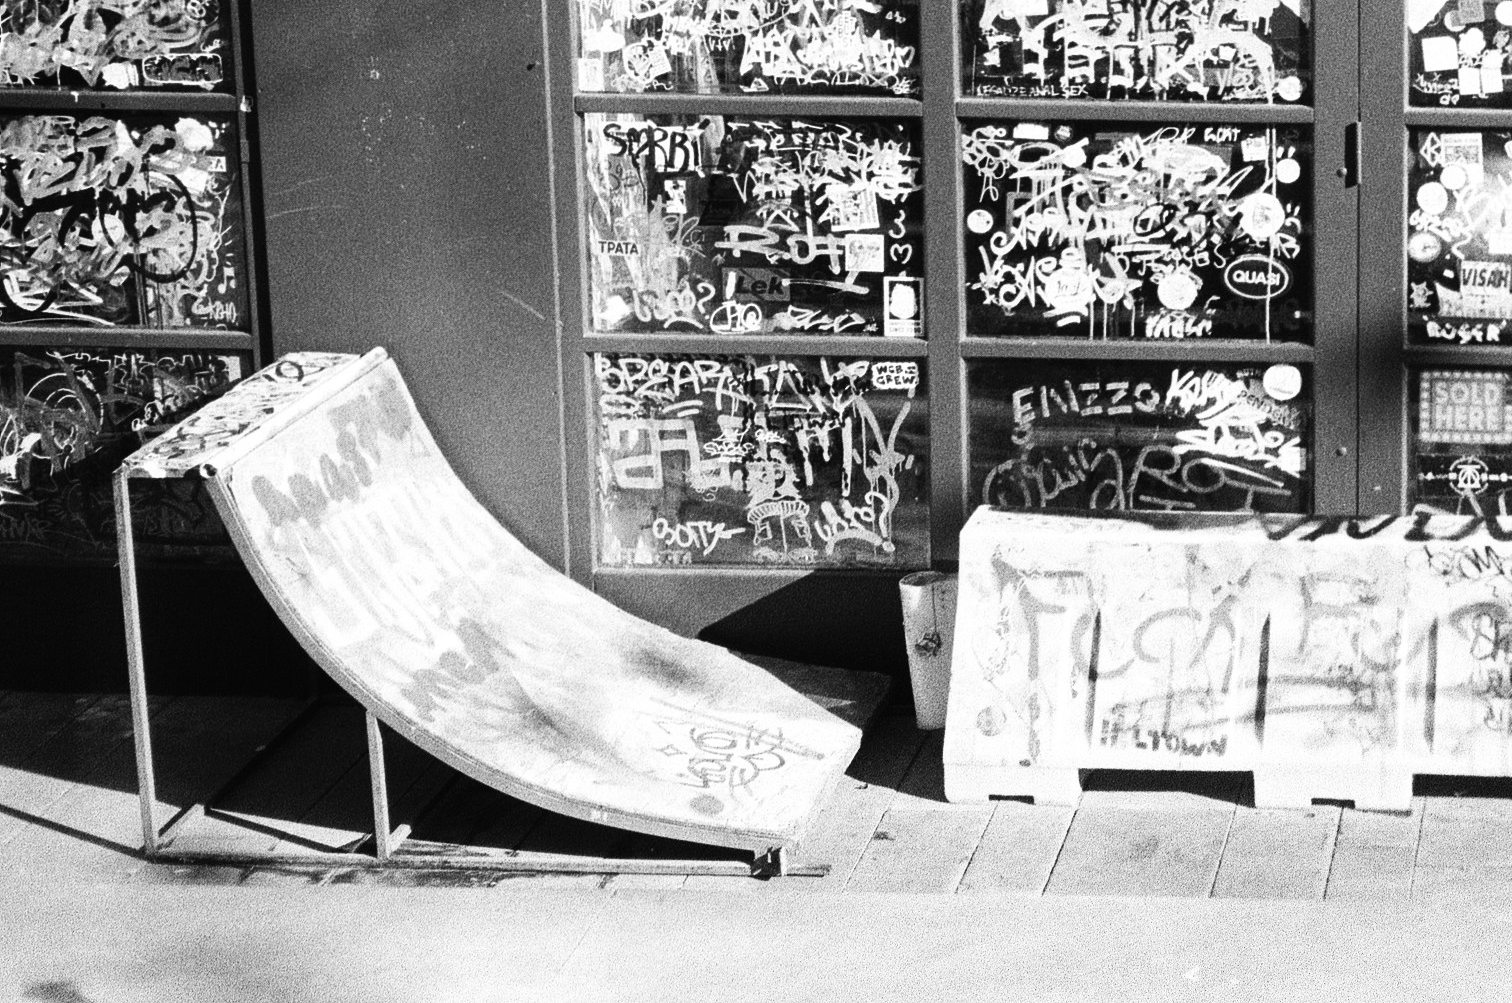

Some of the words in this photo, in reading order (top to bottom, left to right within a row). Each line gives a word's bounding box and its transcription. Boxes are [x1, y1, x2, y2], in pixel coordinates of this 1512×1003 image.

[1062, 84, 1089, 97] SEX
[1232, 270, 1281, 287] QUASI
[1433, 381, 1500, 402] SOLD
[1433, 404, 1506, 430] HERE
